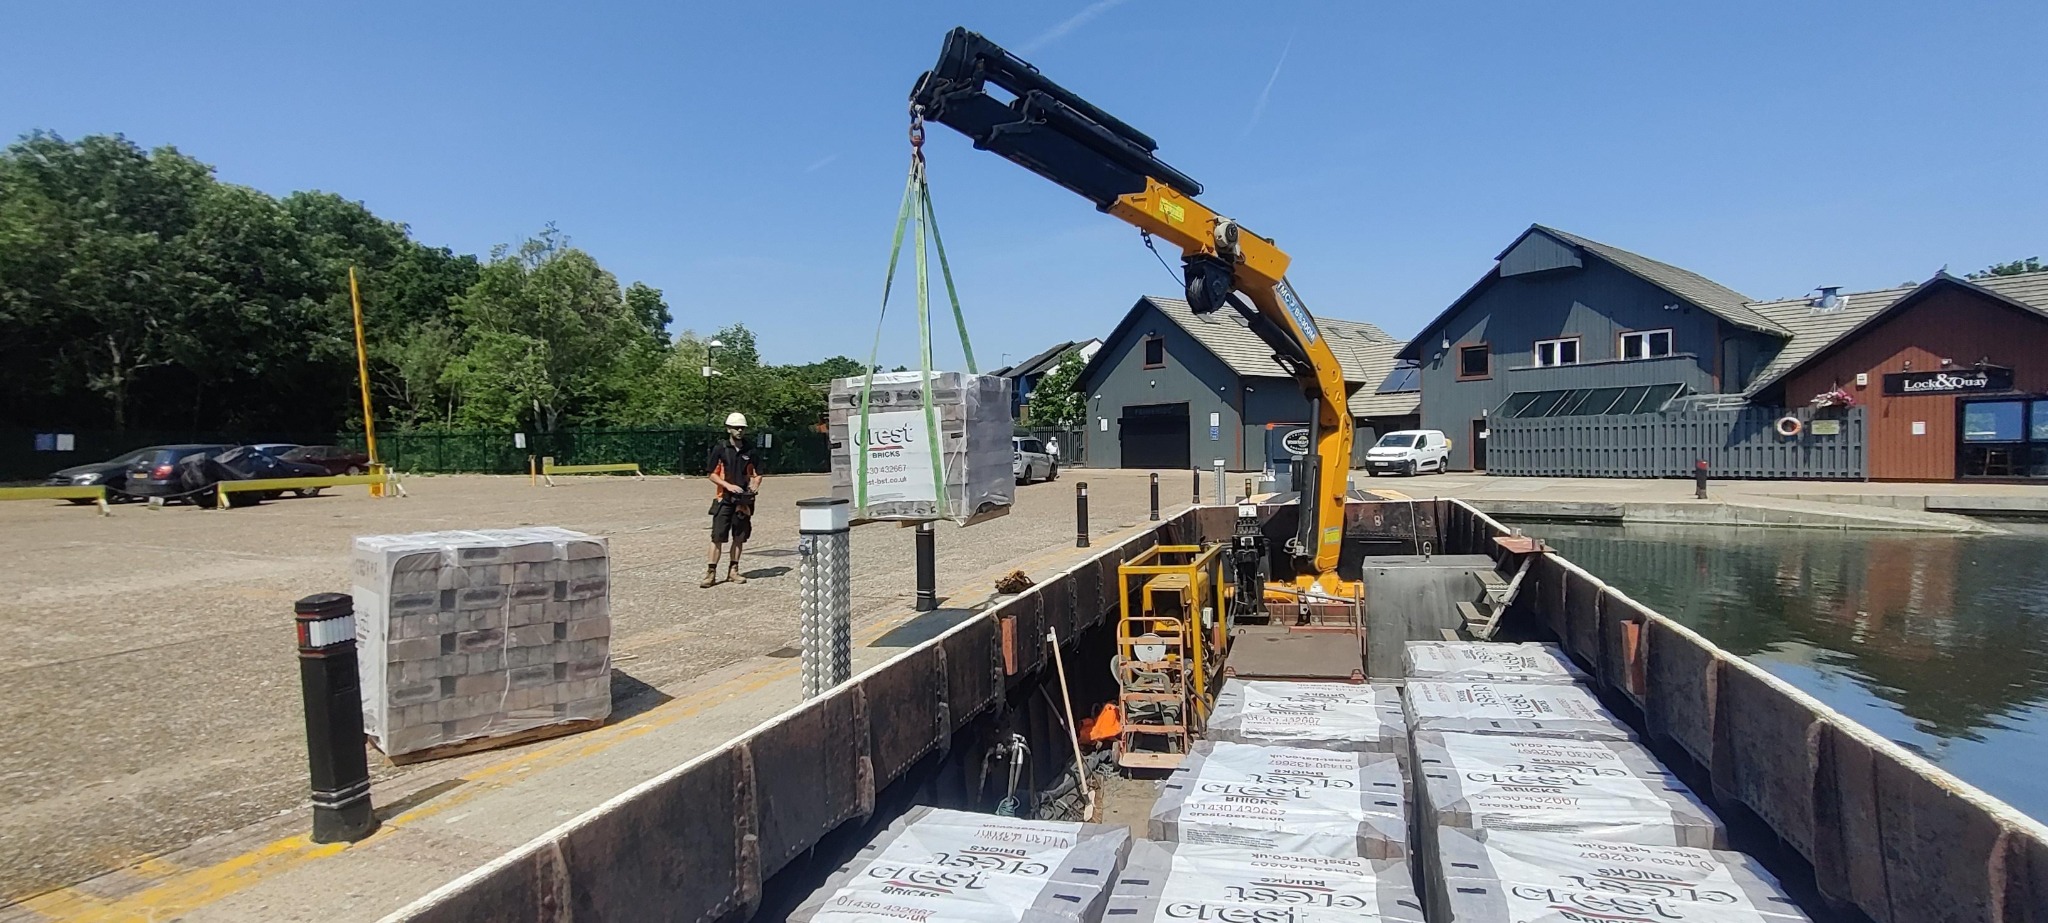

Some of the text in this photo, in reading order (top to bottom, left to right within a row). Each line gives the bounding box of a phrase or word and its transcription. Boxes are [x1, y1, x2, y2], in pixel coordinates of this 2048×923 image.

[872, 450, 901, 459] BRICKS
[880, 464, 907, 474] 432667
[1246, 773, 1354, 790] crest
[1501, 786, 1563, 794] BRICKS
[1201, 782, 1312, 800] crest
[970, 845, 1027, 857] BRICKS
[928, 852, 1050, 877] crest
[1251, 852, 1362, 868] crest-bst.co.uk
[868, 866, 990, 890] crest
[1224, 885, 1368, 910] crest
[1555, 875, 1739, 903] crest
[836, 895, 881, 909] 01430
[1512, 886, 1686, 919] crest
[1165, 902, 1310, 923] crest
